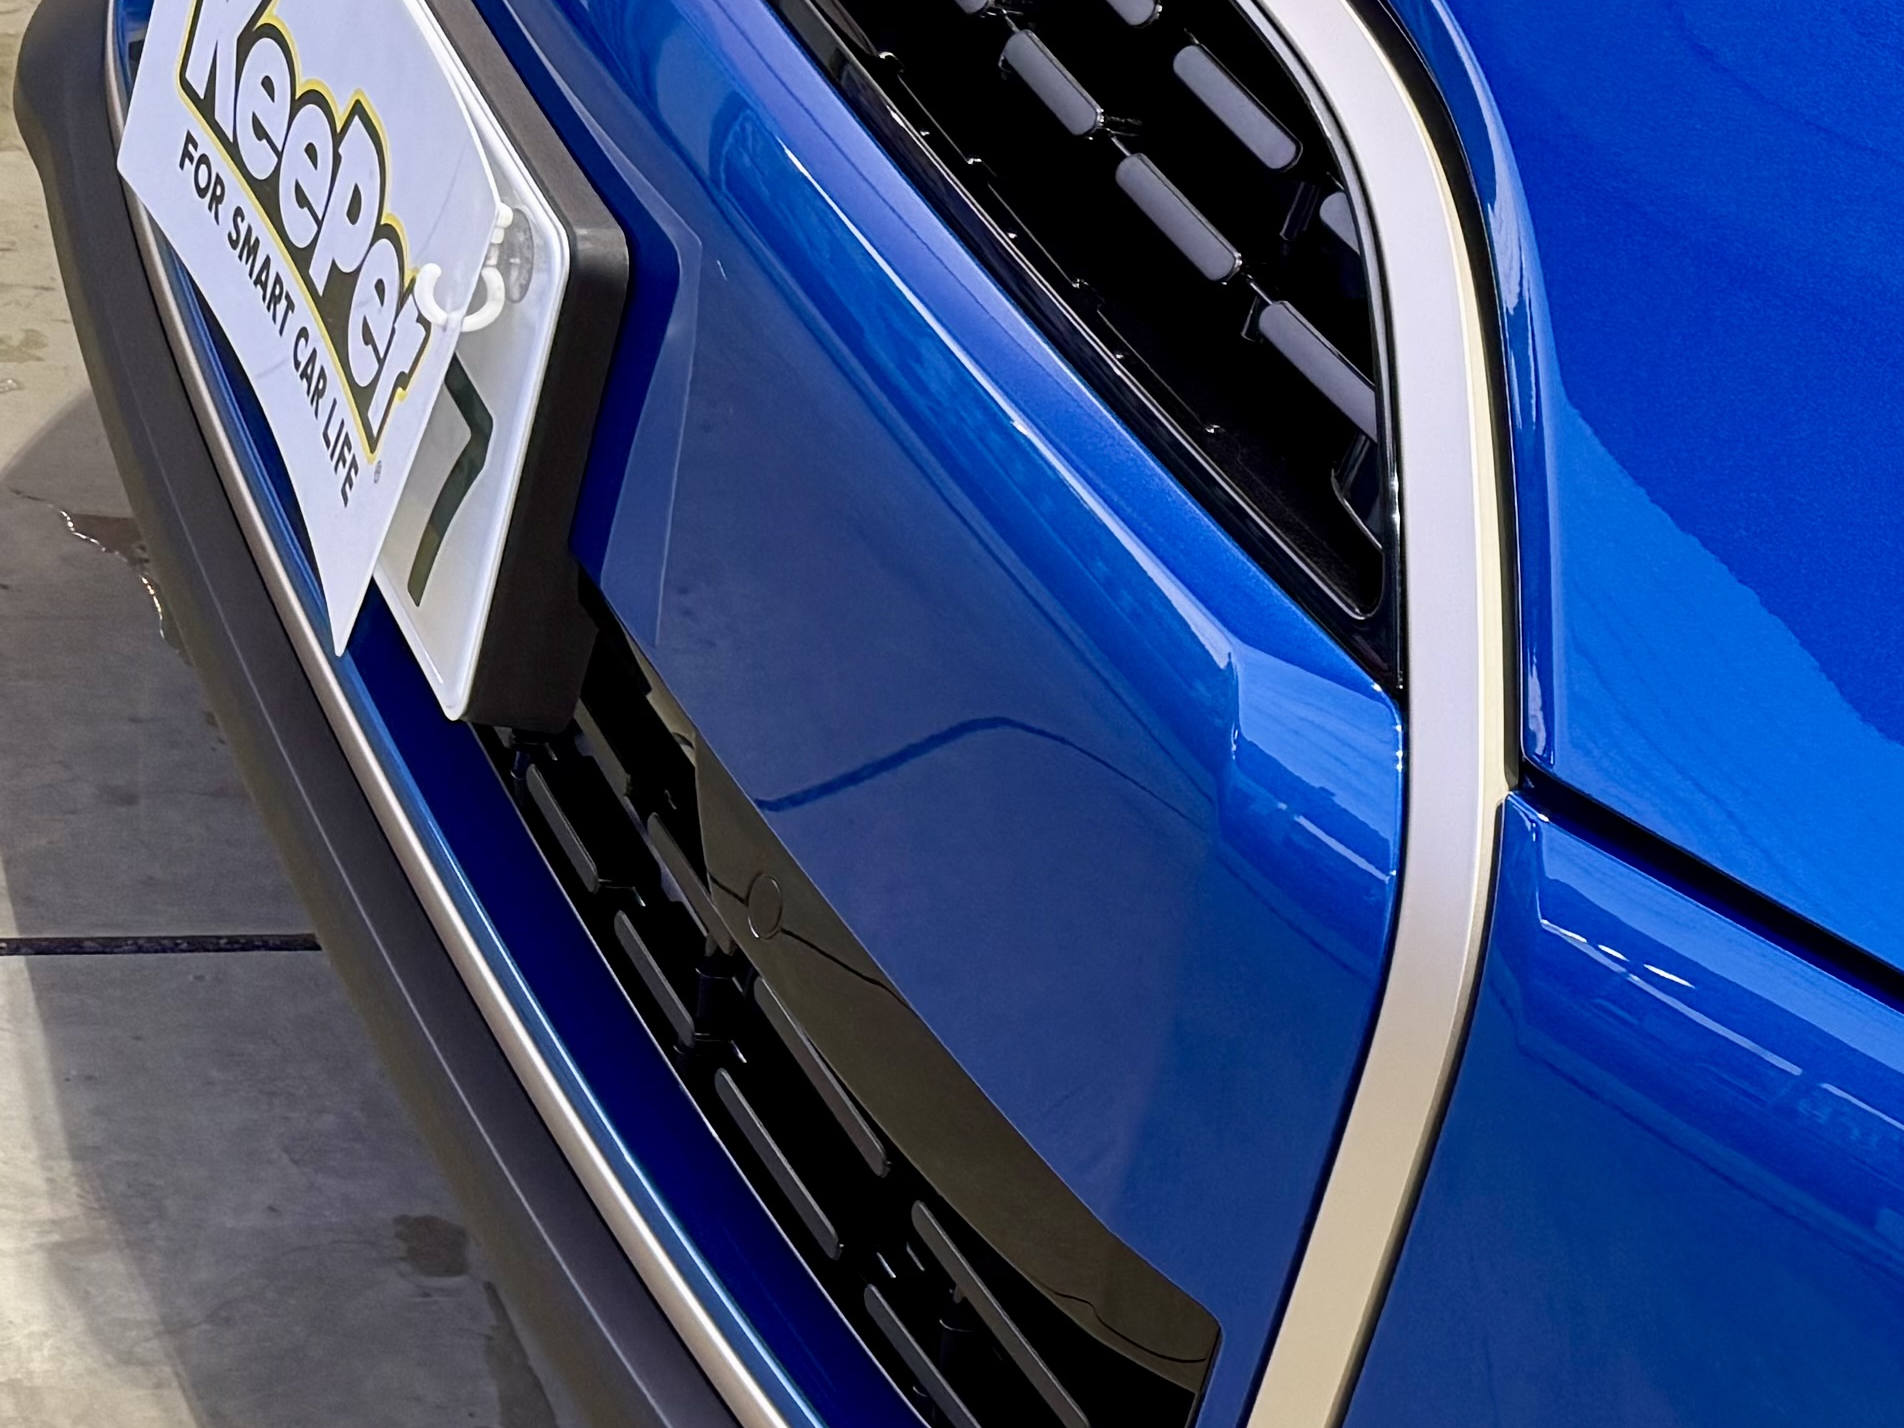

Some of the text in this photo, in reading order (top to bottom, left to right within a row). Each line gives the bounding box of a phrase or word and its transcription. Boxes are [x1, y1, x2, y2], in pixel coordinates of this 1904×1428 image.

[178, 128, 359, 508] FOR SMART CAR LIFE
